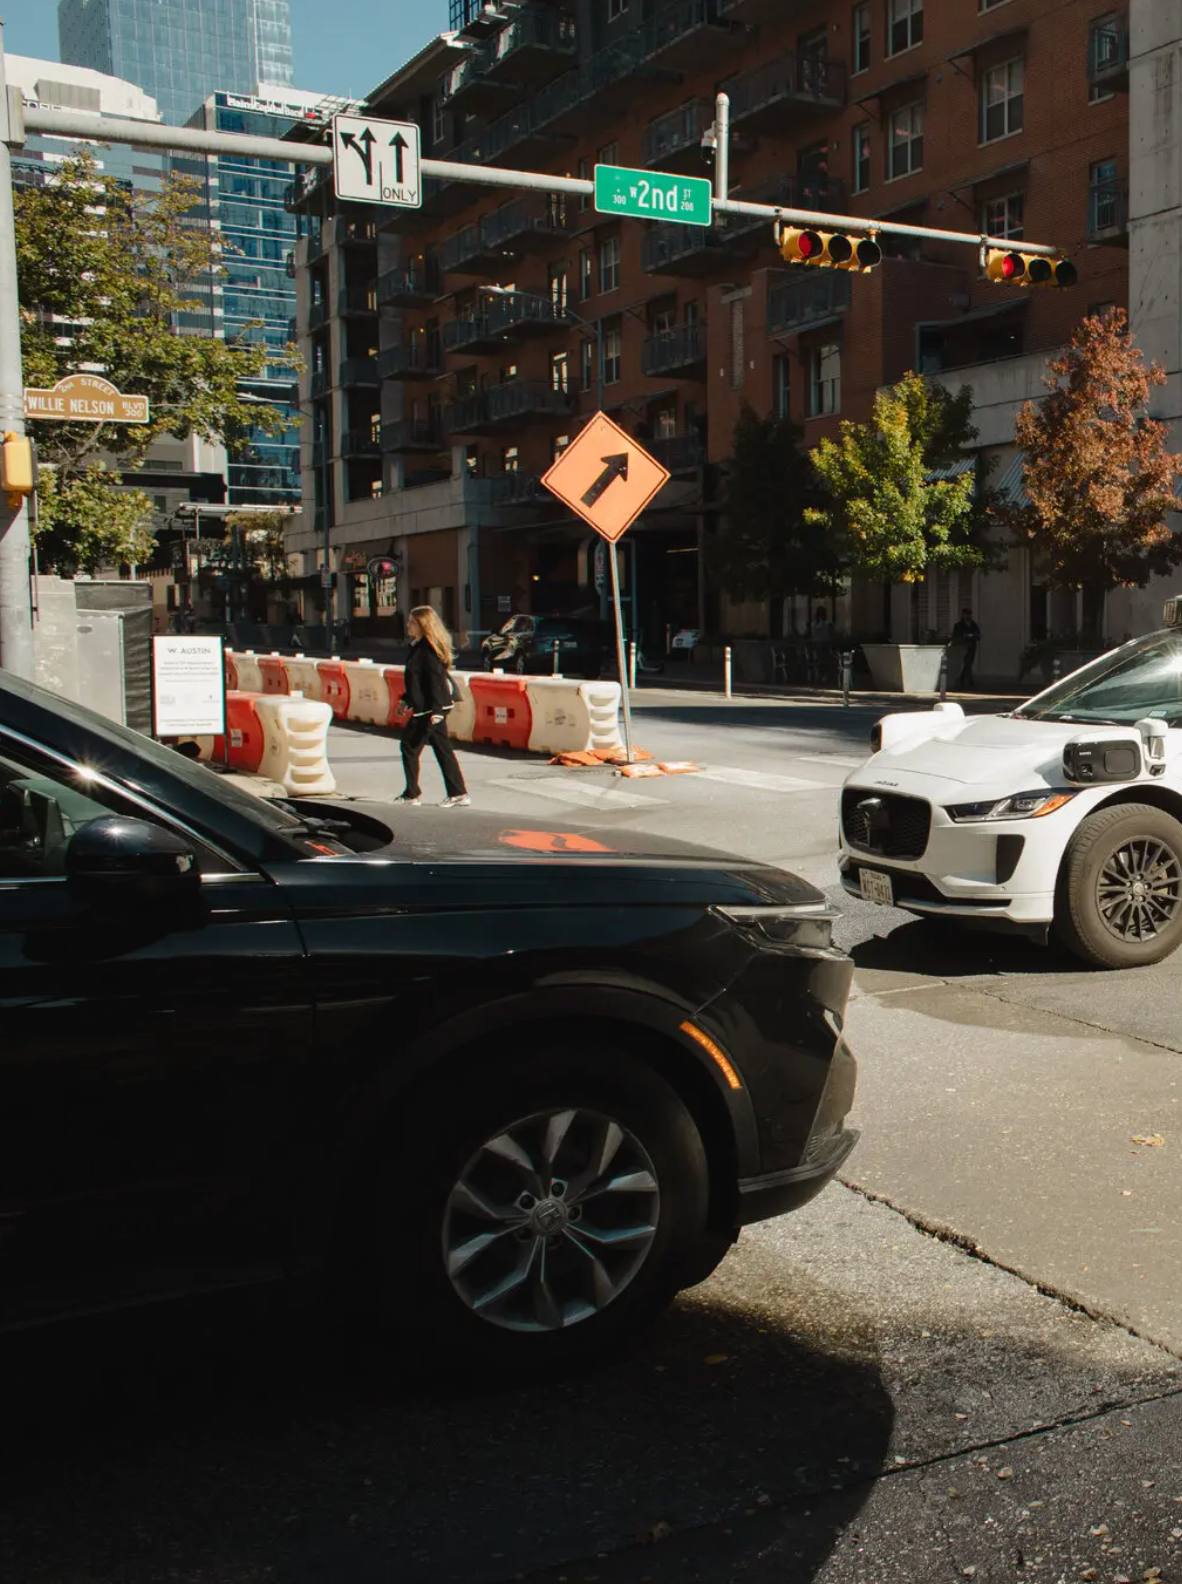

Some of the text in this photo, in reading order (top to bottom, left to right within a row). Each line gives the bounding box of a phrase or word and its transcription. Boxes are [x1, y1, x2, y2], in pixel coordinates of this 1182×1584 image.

[382, 187, 417, 202] ONLY
[612, 194, 627, 205] 300
[629, 186, 637, 198] W
[638, 179, 678, 212] 2nd
[680, 201, 694, 212] 200
[80, 378, 116, 397] STREET
[27, 395, 115, 416] WILLIE NELSON
[122, 401, 145, 411] BLVD
[180, 647, 212, 655] AUSTIN
